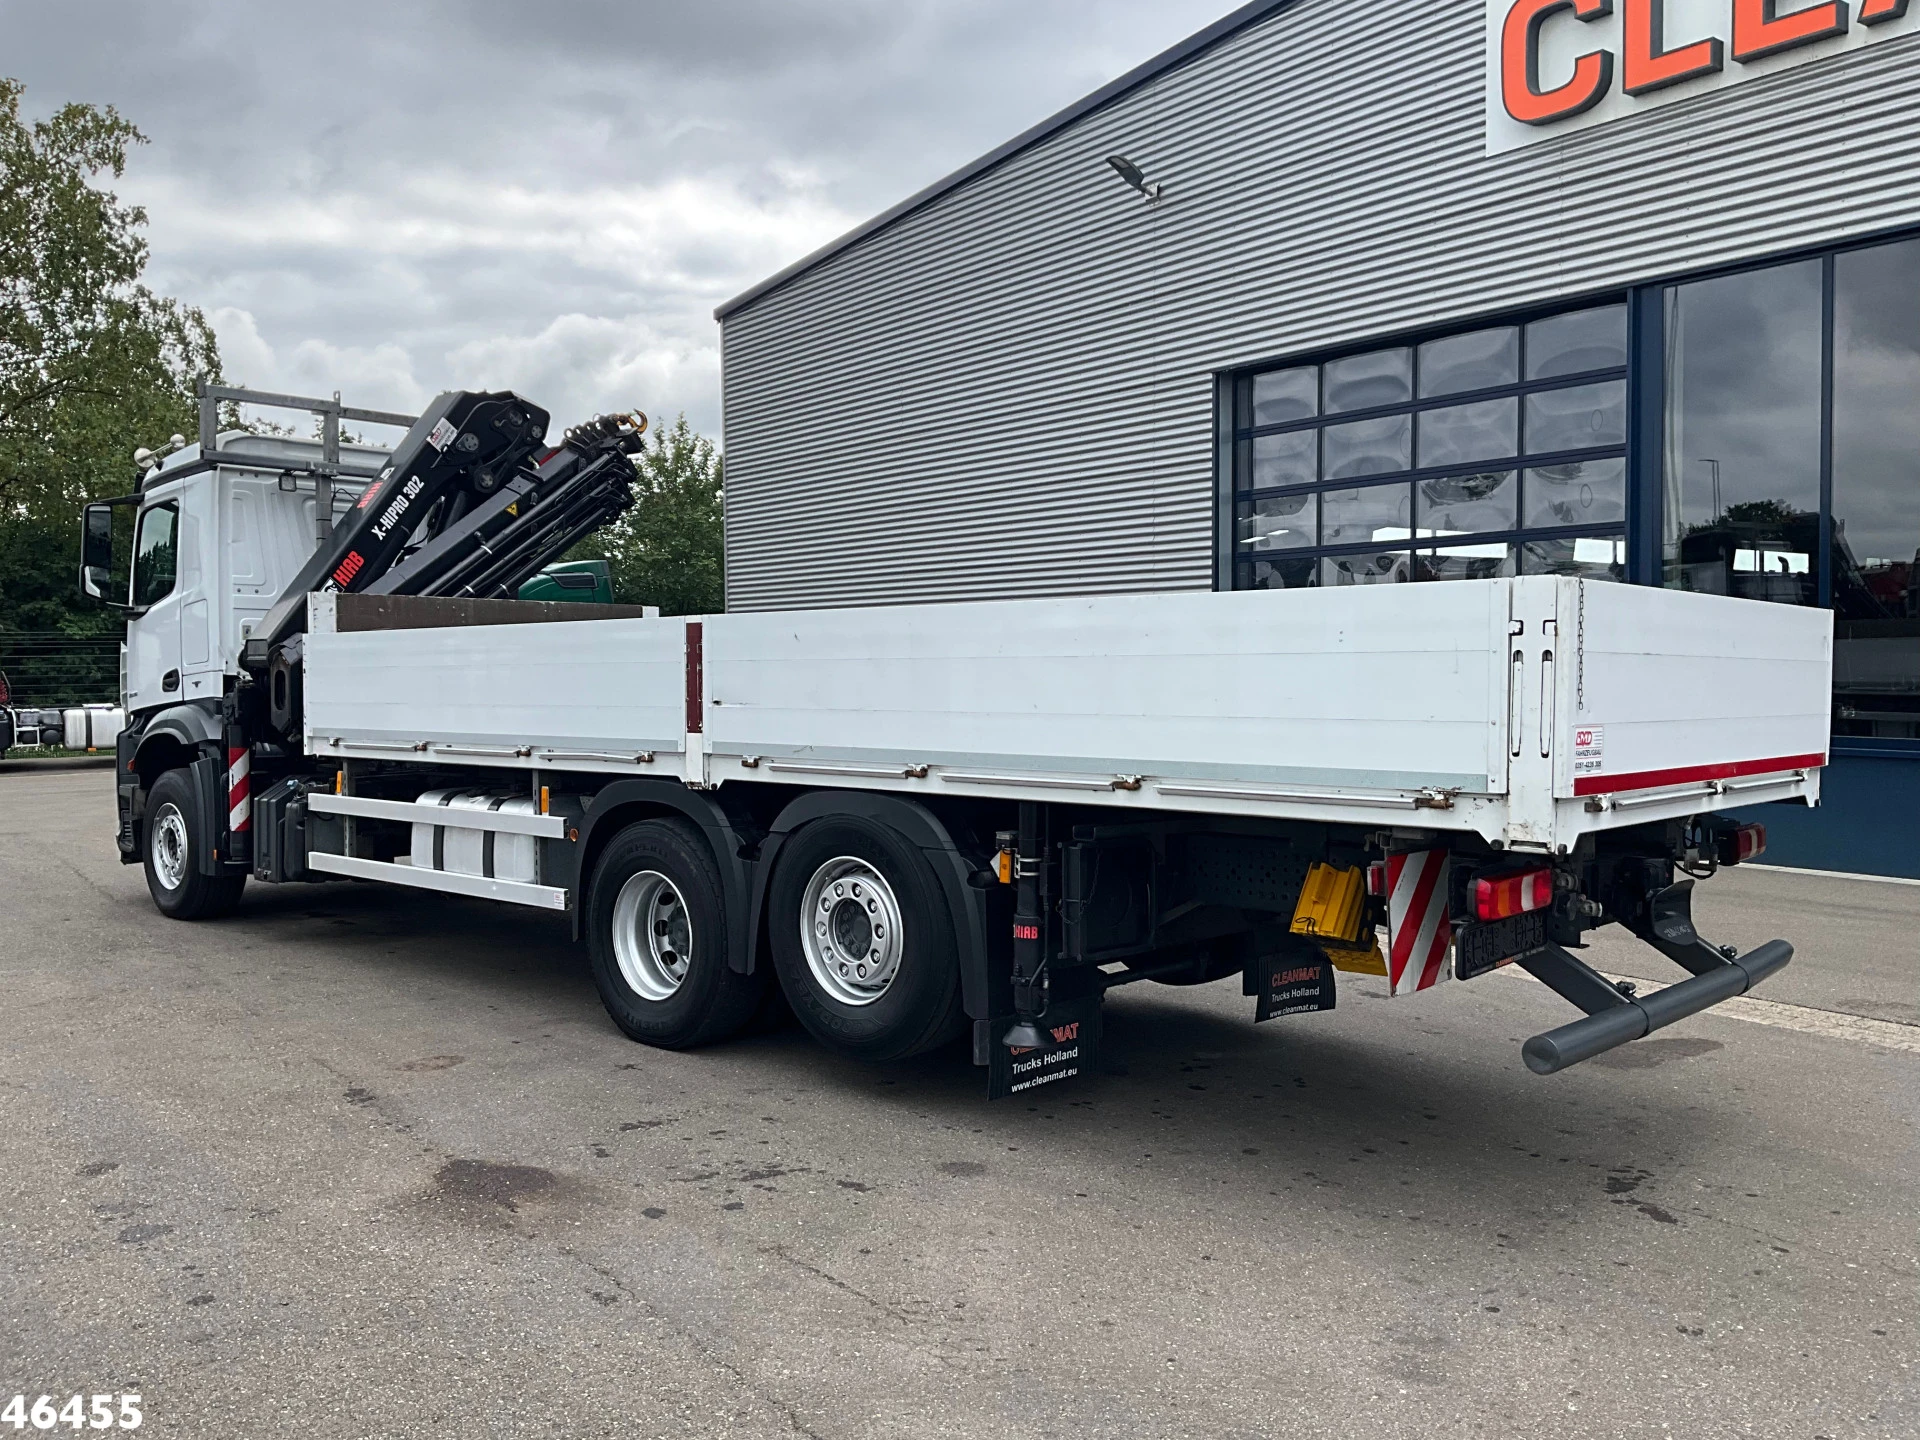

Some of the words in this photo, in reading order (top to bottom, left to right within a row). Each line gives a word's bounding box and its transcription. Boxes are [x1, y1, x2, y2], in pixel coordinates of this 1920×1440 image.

[1501, 0, 1920, 126] CL
[371, 493, 410, 541] X-HIPRO
[403, 475, 425, 501] 302
[333, 550, 365, 587] HIAB
[1014, 923, 1038, 939] HIAB
[1271, 966, 1321, 988] CLEANMAT
[1271, 990, 1290, 1003] Trucks
[1291, 986, 1320, 998] Holland
[1269, 1003, 1319, 1018] www.cleanmat.eu
[1012, 1057, 1042, 1075] Trucks
[1043, 1046, 1078, 1066] Holland
[1011, 1067, 1078, 1093] www.cleanmat.eu
